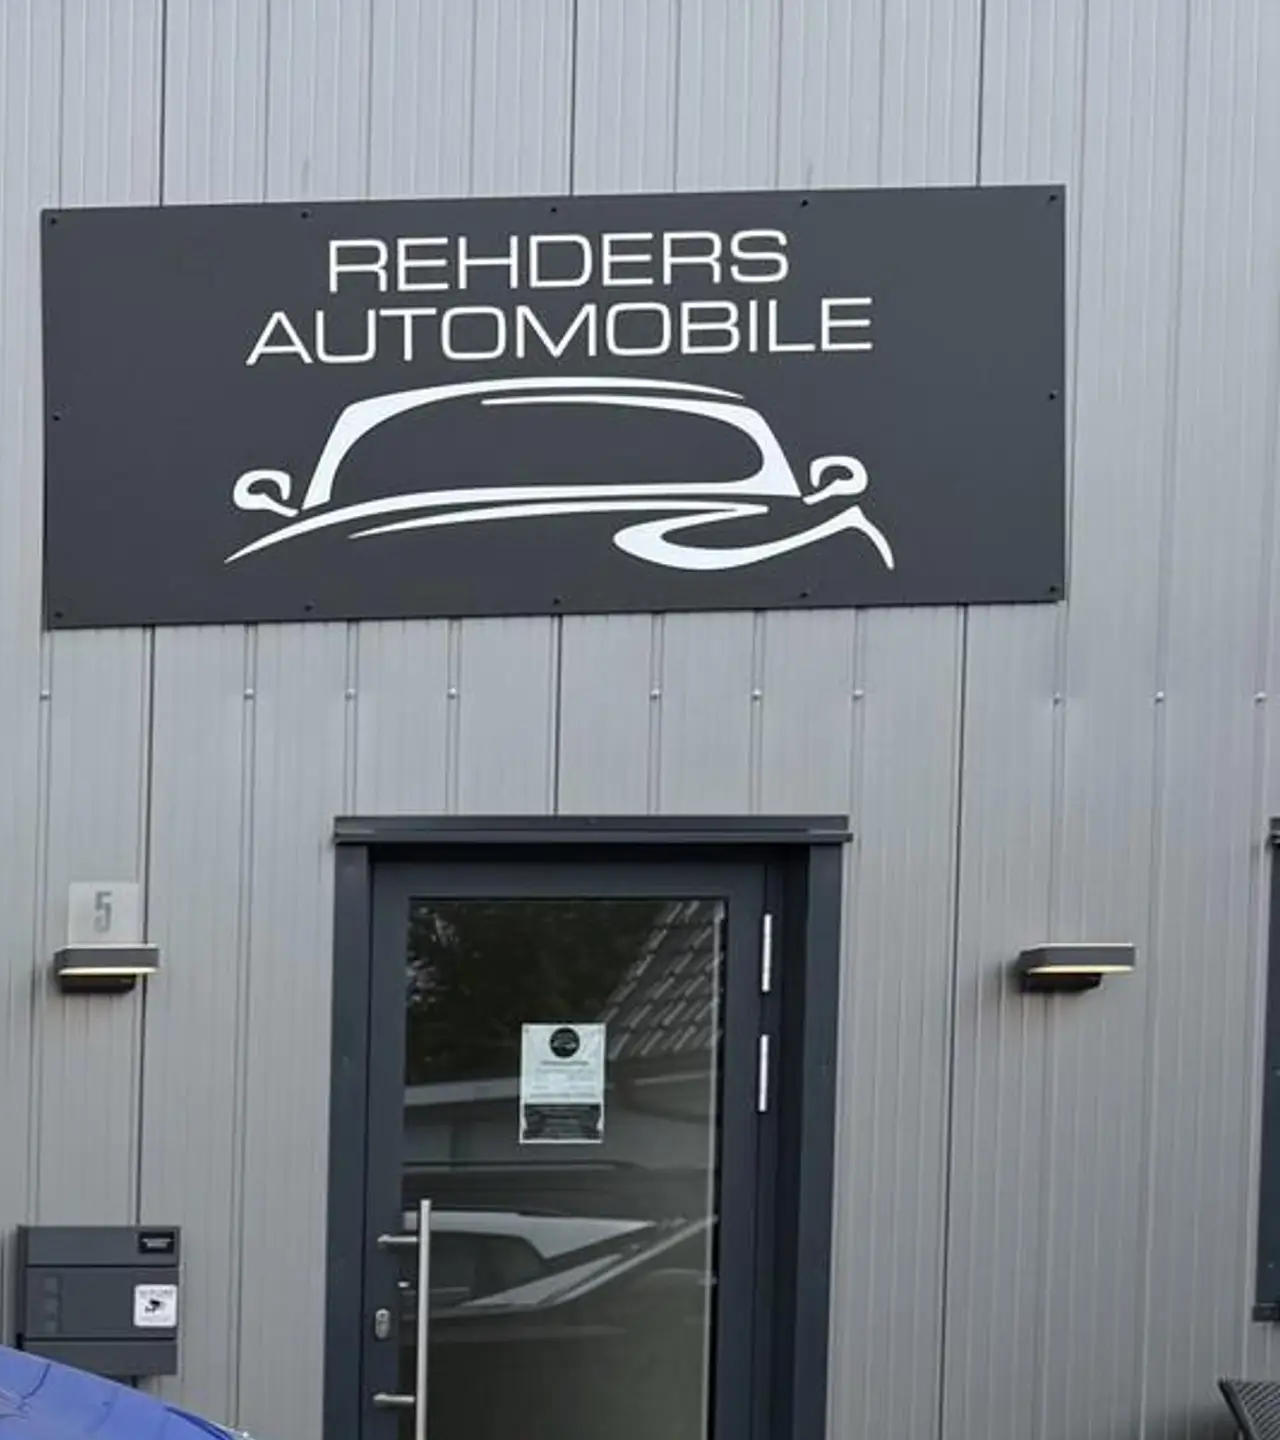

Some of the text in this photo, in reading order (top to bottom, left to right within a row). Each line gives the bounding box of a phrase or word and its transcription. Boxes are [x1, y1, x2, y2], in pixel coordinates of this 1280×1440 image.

[328, 229, 789, 293] REHDERS
[245, 295, 873, 366] AUTOMOBILE
[93, 890, 112, 934] 5
